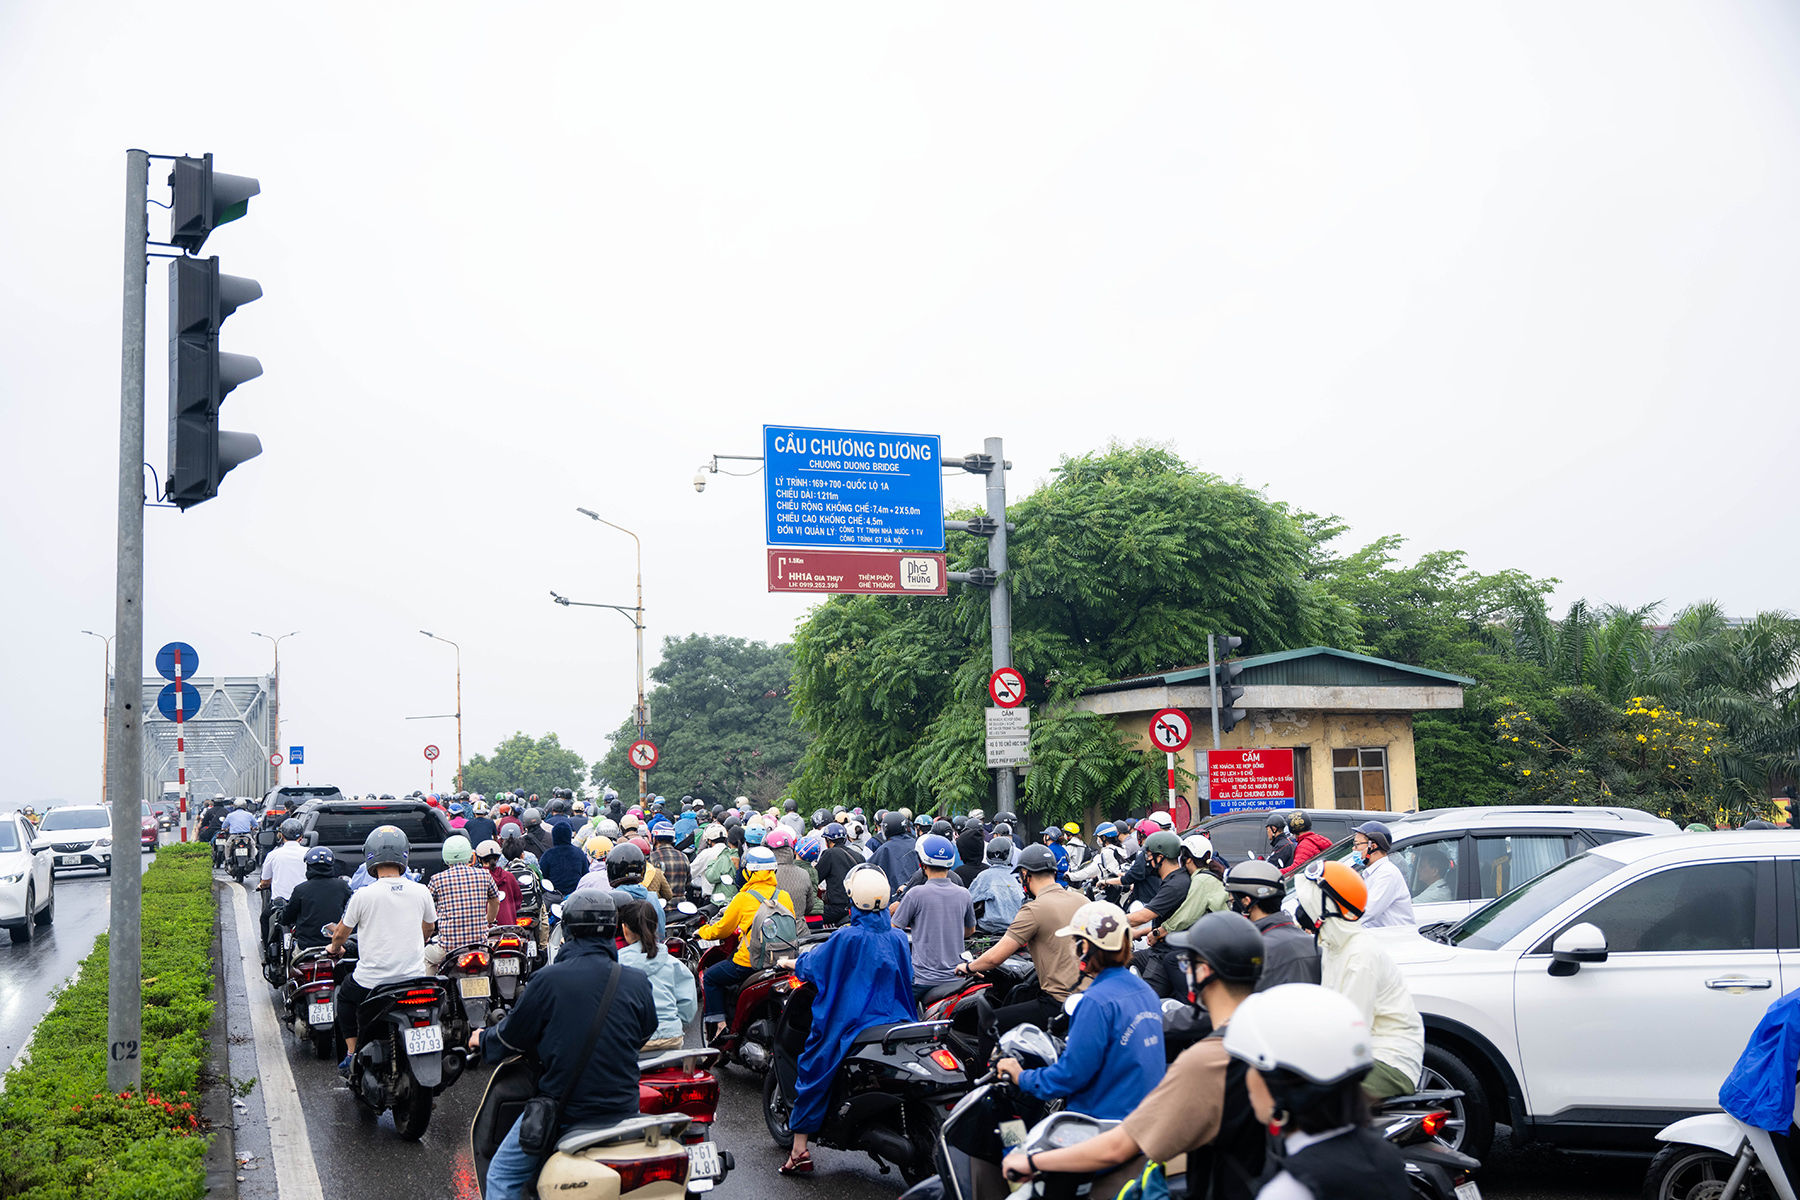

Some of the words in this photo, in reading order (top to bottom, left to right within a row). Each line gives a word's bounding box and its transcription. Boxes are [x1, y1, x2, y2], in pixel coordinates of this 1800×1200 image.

[775, 432, 806, 454] CẦU
[810, 438, 875, 457] CHƯƠNG
[880, 441, 931, 460] DƯƠNG
[810, 460, 841, 469] CHUONG
[844, 461, 870, 471] DUONG
[872, 462, 900, 472] BRIDGE
[776, 476, 784, 486] LÝ
[869, 480, 878, 491] LỘ
[881, 482, 889, 491] 1A
[802, 500, 823, 512] RỘNG
[826, 501, 852, 512] KHỐNG
[802, 514, 817, 523] CAO
[820, 513, 846, 524] KHỐNG
[777, 524, 793, 534] ĐƠN
[795, 526, 802, 536] VỊ
[805, 525, 825, 535] QUẢN
[894, 536, 903, 545] NỘI
[1242, 750, 1260, 762] CẤM
[411, 1028, 436, 1041] 29-C1
[112, 1040, 138, 1061] C2
[409, 1039, 441, 1053] 937.93
[685, 1145, 711, 1161] 9-G1
[690, 1160, 717, 1176] 4.81
